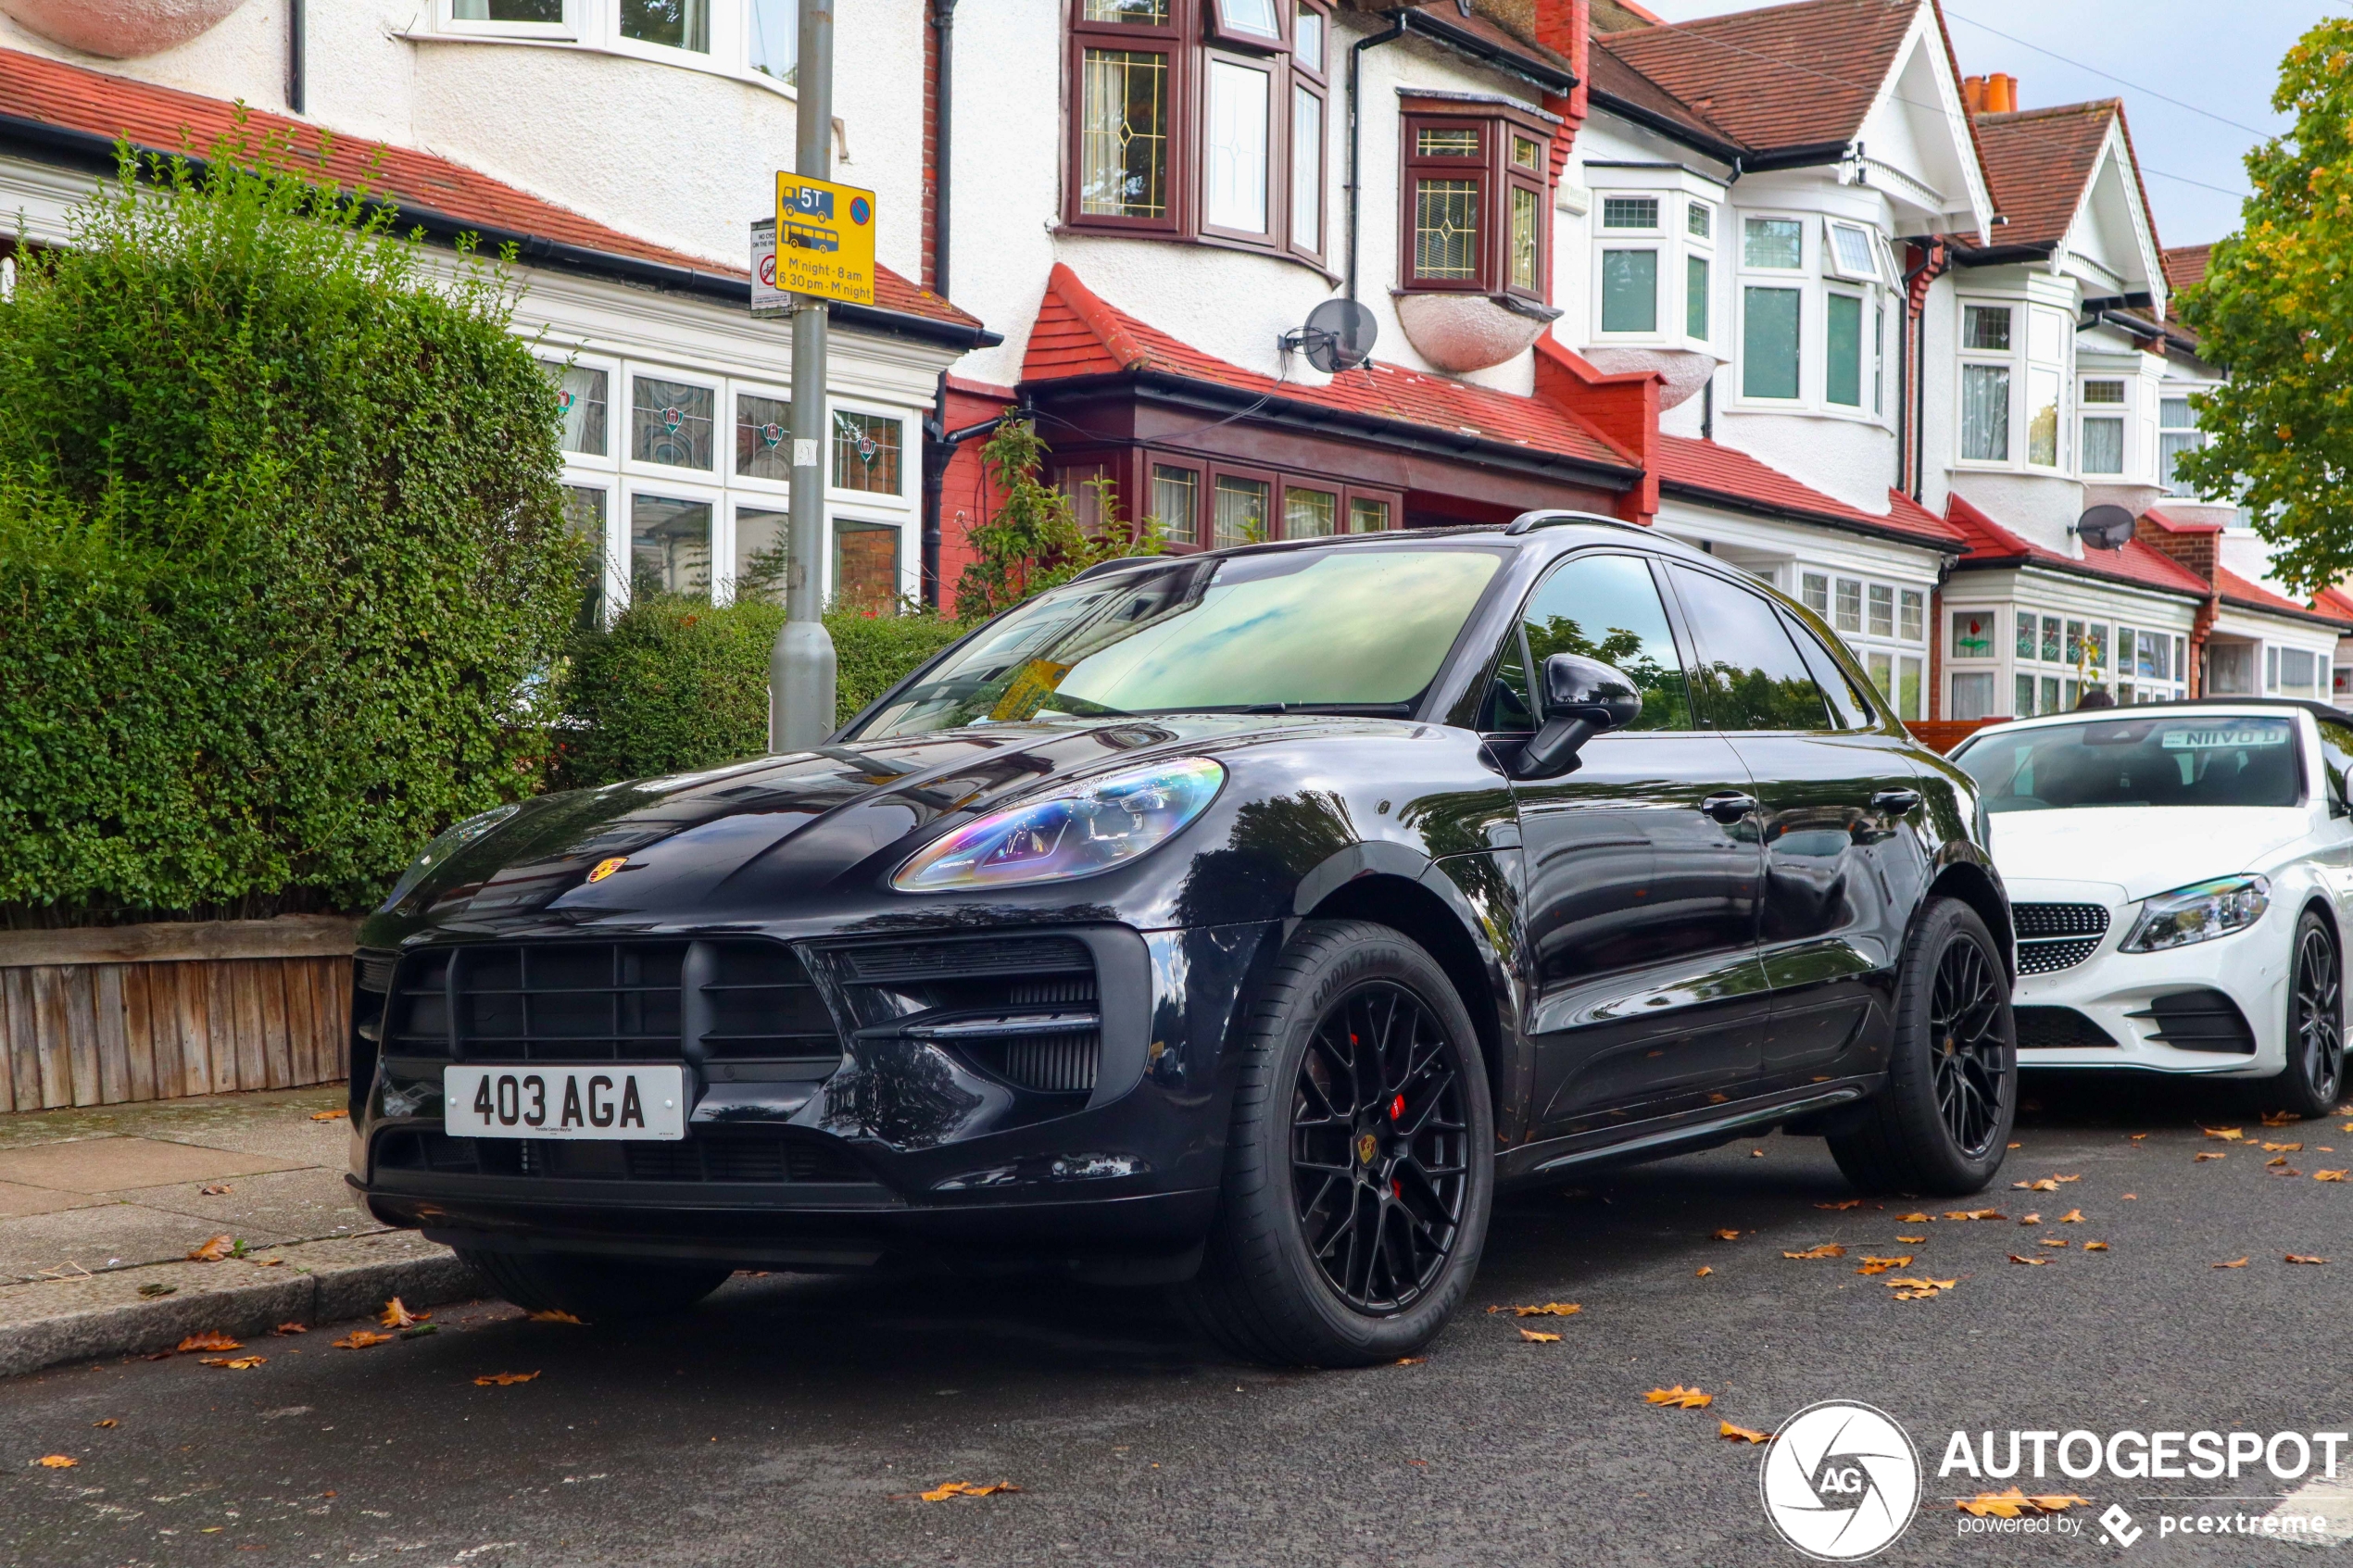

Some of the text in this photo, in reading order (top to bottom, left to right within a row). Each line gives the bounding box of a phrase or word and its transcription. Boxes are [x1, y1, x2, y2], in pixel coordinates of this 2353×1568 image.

[800, 187, 823, 208] 5T
[837, 267, 845, 279] 8
[847, 271, 862, 282] am
[807, 279, 824, 291] pm
[938, 859, 975, 868] PORSCHE
[1312, 948, 1402, 1011] GOODYEAR
[473, 1074, 646, 1128] 403 AGA
